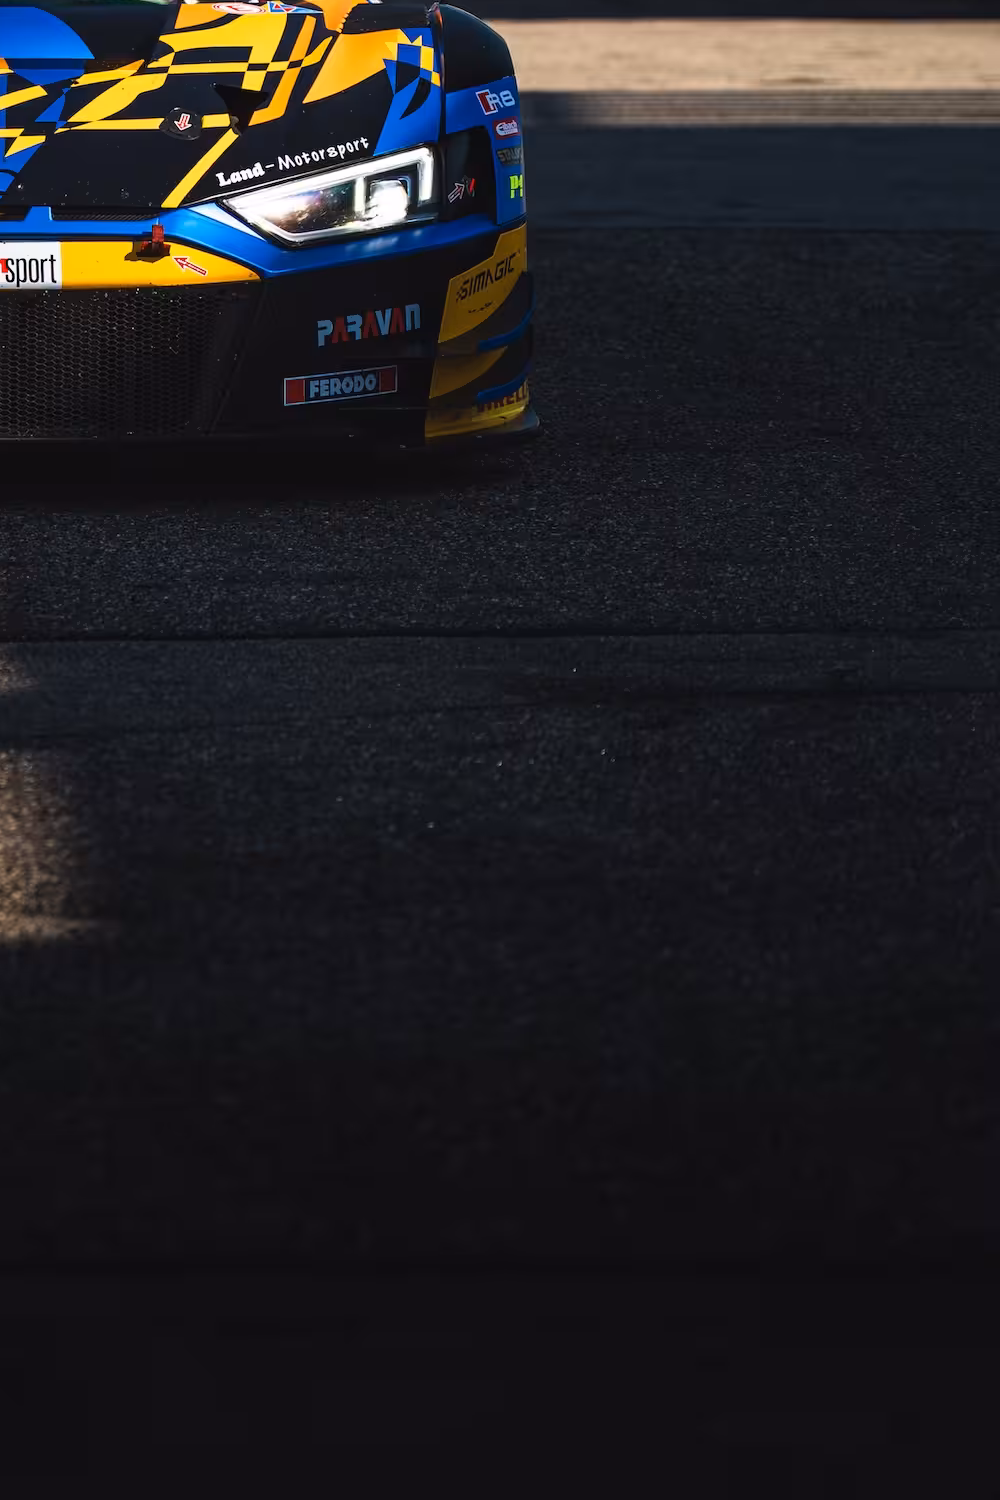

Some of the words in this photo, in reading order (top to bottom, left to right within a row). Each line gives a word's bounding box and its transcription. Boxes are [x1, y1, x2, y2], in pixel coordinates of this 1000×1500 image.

[480, 89, 515, 112] R8
[456, 253, 517, 301] SIMAGIC
[317, 303, 421, 347] PARAVAN
[309, 373, 377, 399] FERODO
